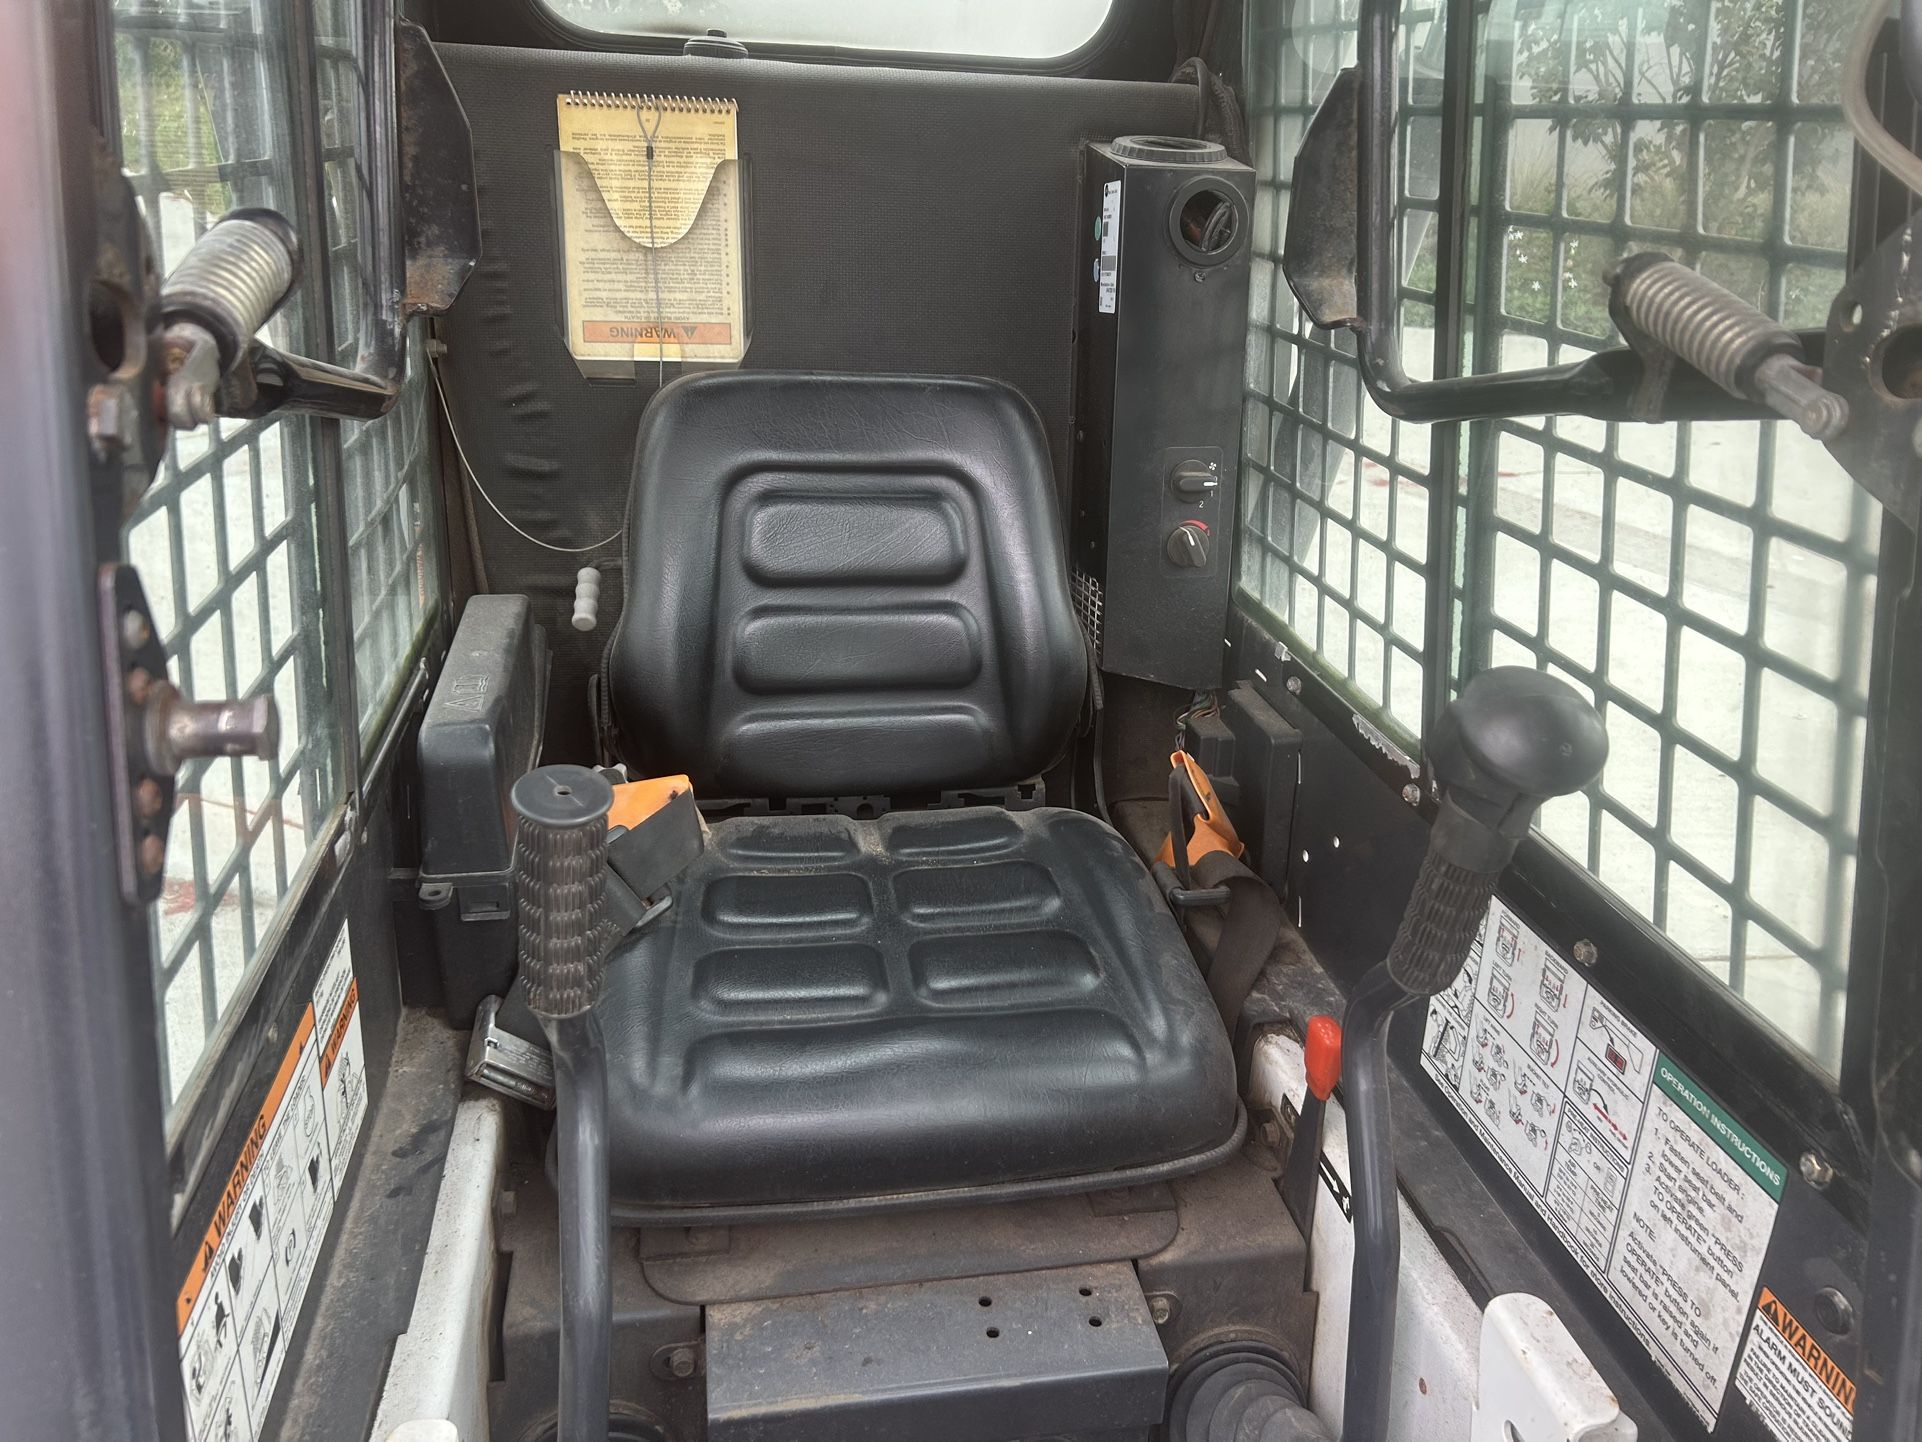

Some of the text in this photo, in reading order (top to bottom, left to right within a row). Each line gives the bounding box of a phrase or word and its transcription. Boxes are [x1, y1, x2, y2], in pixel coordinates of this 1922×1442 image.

[609, 327, 676, 339] WARNING
[1199, 500, 1205, 508] 2
[1567, 1106, 1589, 1135] PRE-HEAT
[1589, 1131, 1624, 1173] INSTRUCTIONS
[1656, 1106, 1668, 1123] TO
[1669, 1118, 1705, 1161] OPERATE
[1660, 1065, 1781, 1187] OPERATION INSTRUCTIONS
[214, 1114, 266, 1238] WARNING
[1655, 1172, 1686, 1212] Activate
[1685, 1207, 1709, 1240] green
[1658, 1161, 1677, 1187] Start
[1677, 1181, 1706, 1221] engine.
[1660, 1148, 1717, 1214] lower seat bar.
[1664, 1136, 1690, 1169] Fasten
[1691, 1165, 1709, 1189] seat
[1709, 1183, 1726, 1206] belt
[1726, 1201, 1743, 1225] and
[1444, 1085, 1468, 1119] Operation
[1468, 1115, 1478, 1132] and
[1478, 1128, 1512, 1175] Maintenance
[1513, 1171, 1533, 1202] Manual
[1534, 1198, 1546, 1217] and
[1547, 1214, 1579, 1258] Handbook
[1579, 1254, 1589, 1271] for
[1589, 1267, 1608, 1294] more
[1608, 1291, 1652, 1350] instructions.
[1632, 1210, 1656, 1243] NOTE:
[1649, 1197, 1740, 1306] on left instrument panel.
[1652, 1184, 1664, 1203] TO
[1706, 1244, 1733, 1280] button
[1623, 1252, 1699, 1349] seat bar is raised and
[1628, 1228, 1657, 1268] Activate
[1688, 1298, 1701, 1319] TO
[1619, 1263, 1718, 1389] lowered or key is turned off.
[1664, 1286, 1689, 1322] button
[1689, 1318, 1711, 1350] again
[1711, 1343, 1718, 1355] if
[1753, 1321, 1786, 1365] ALARM
[1787, 1361, 1817, 1401] MUST
